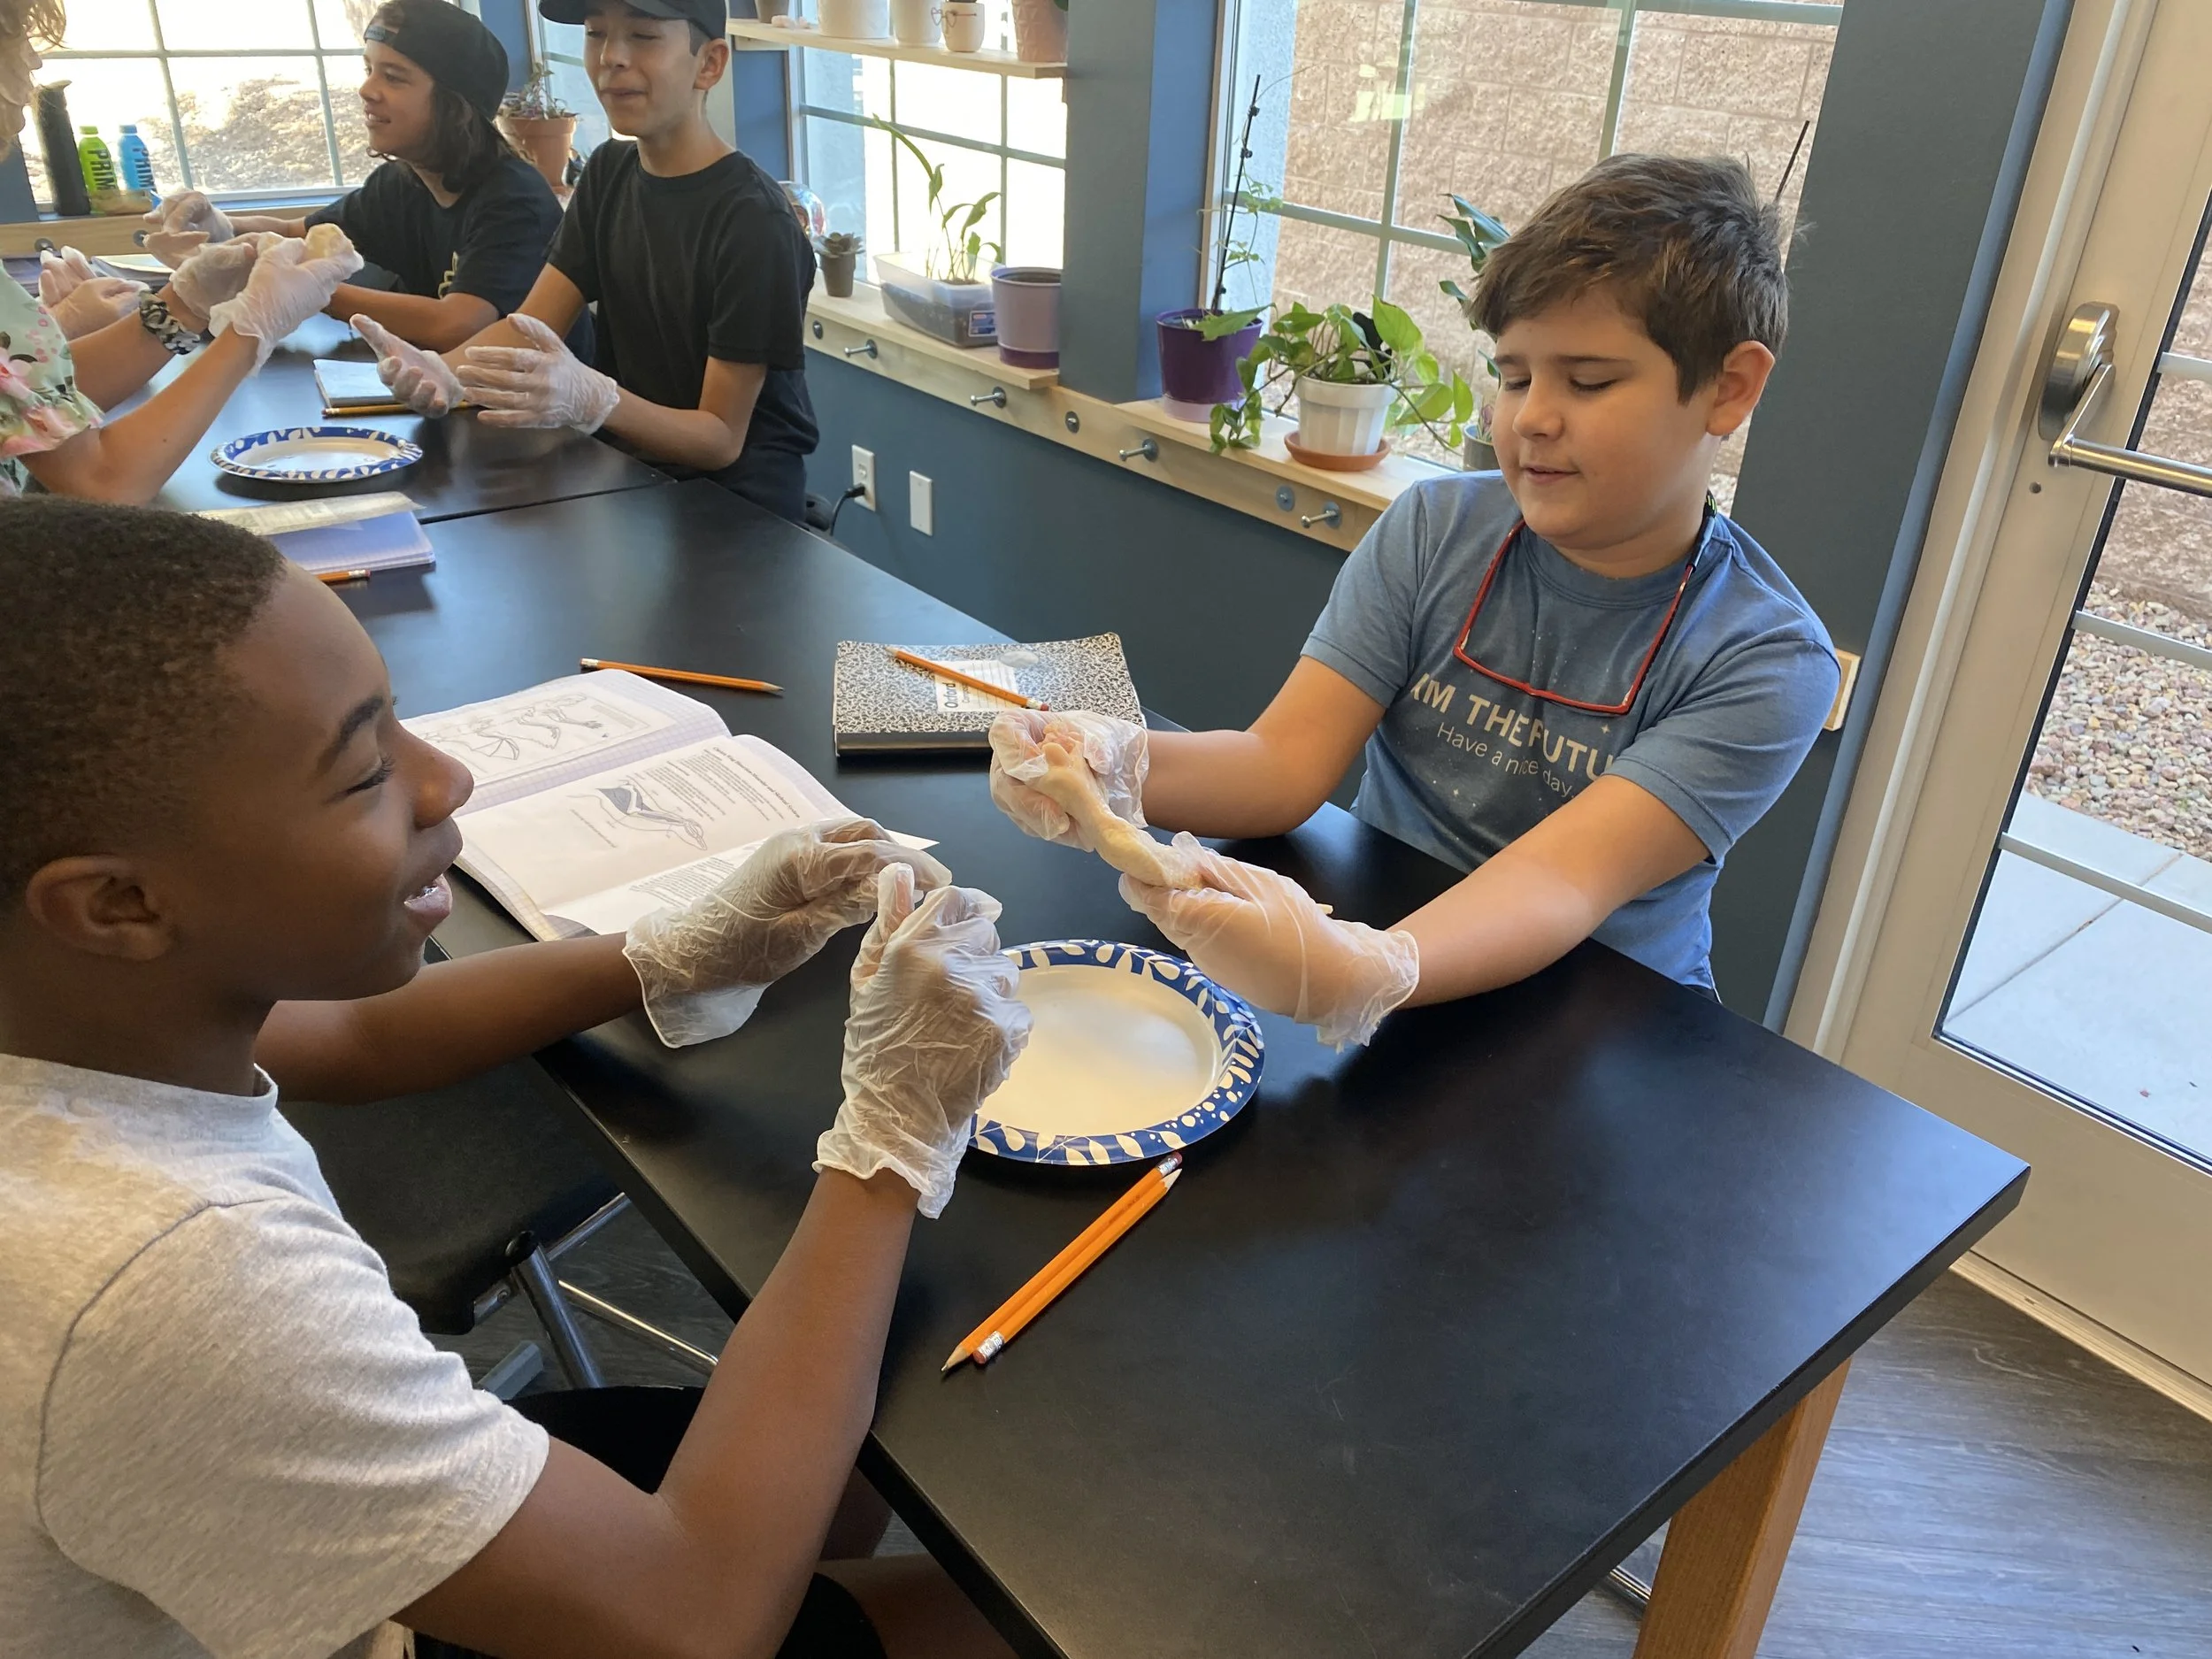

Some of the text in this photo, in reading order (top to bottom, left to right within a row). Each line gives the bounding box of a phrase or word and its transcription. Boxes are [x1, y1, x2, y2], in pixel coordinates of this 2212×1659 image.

[88, 149, 116, 191] PRIM
[1437, 722, 1487, 757] Have
[1491, 750, 1502, 766] a
[1505, 757, 1539, 775] nice
[1467, 694, 1529, 747] THE
[1528, 718, 1614, 782] FUTU
